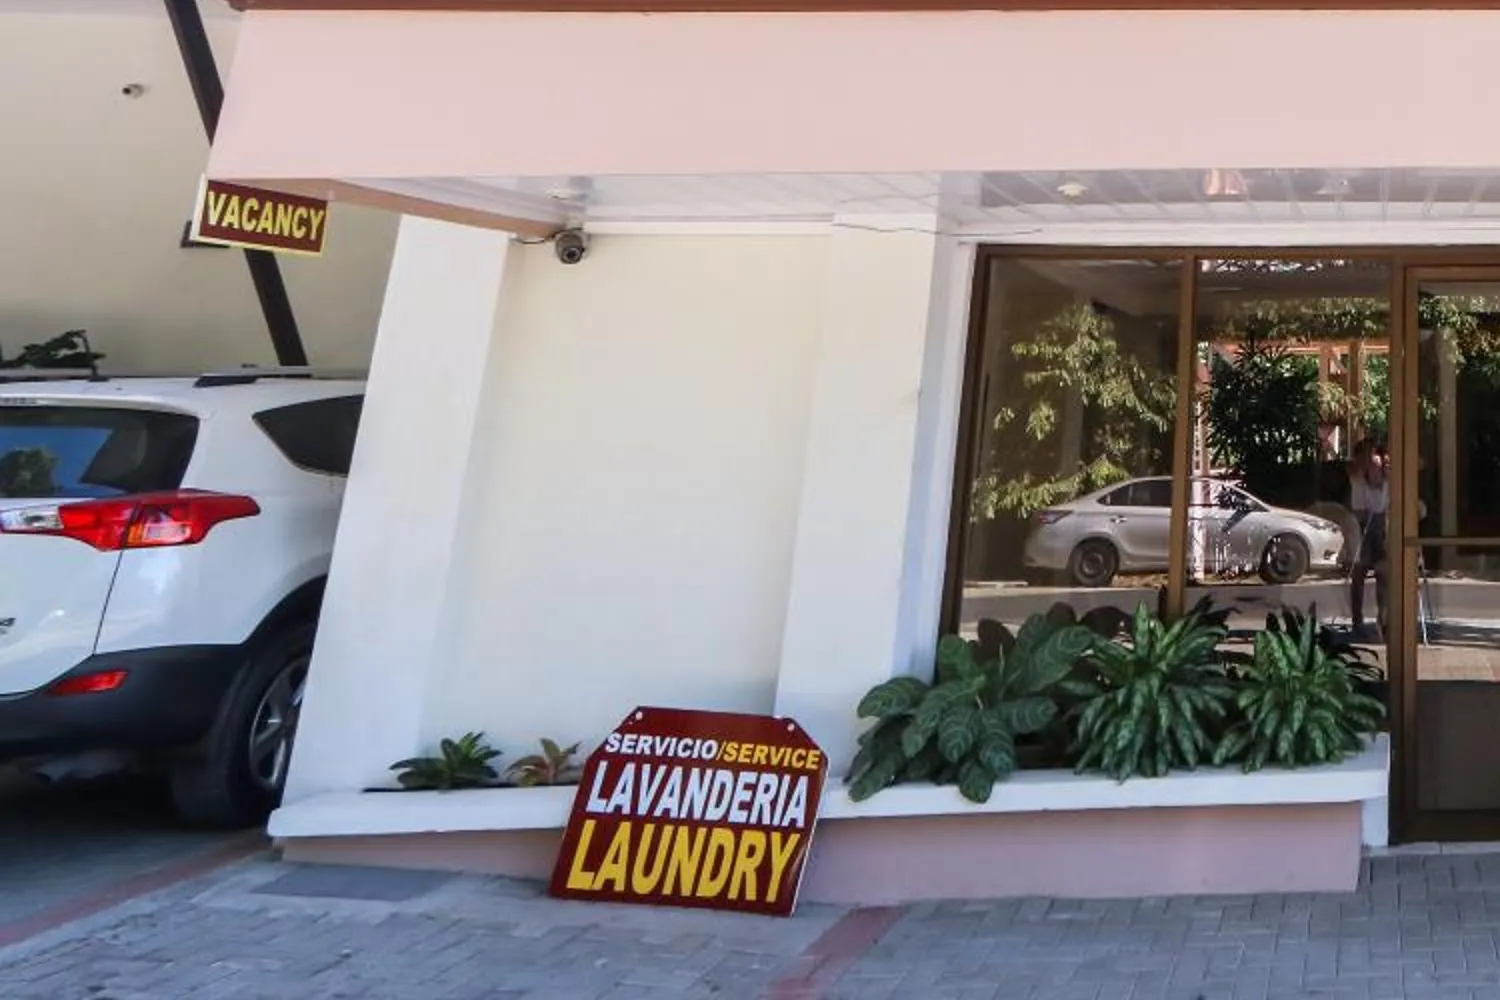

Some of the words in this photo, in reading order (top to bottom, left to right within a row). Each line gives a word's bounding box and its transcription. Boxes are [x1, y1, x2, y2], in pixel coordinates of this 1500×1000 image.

[208, 190, 324, 241] VACANCY
[585, 761, 809, 828] LAVANDERIA
[566, 819, 801, 903] LAUNDRY
